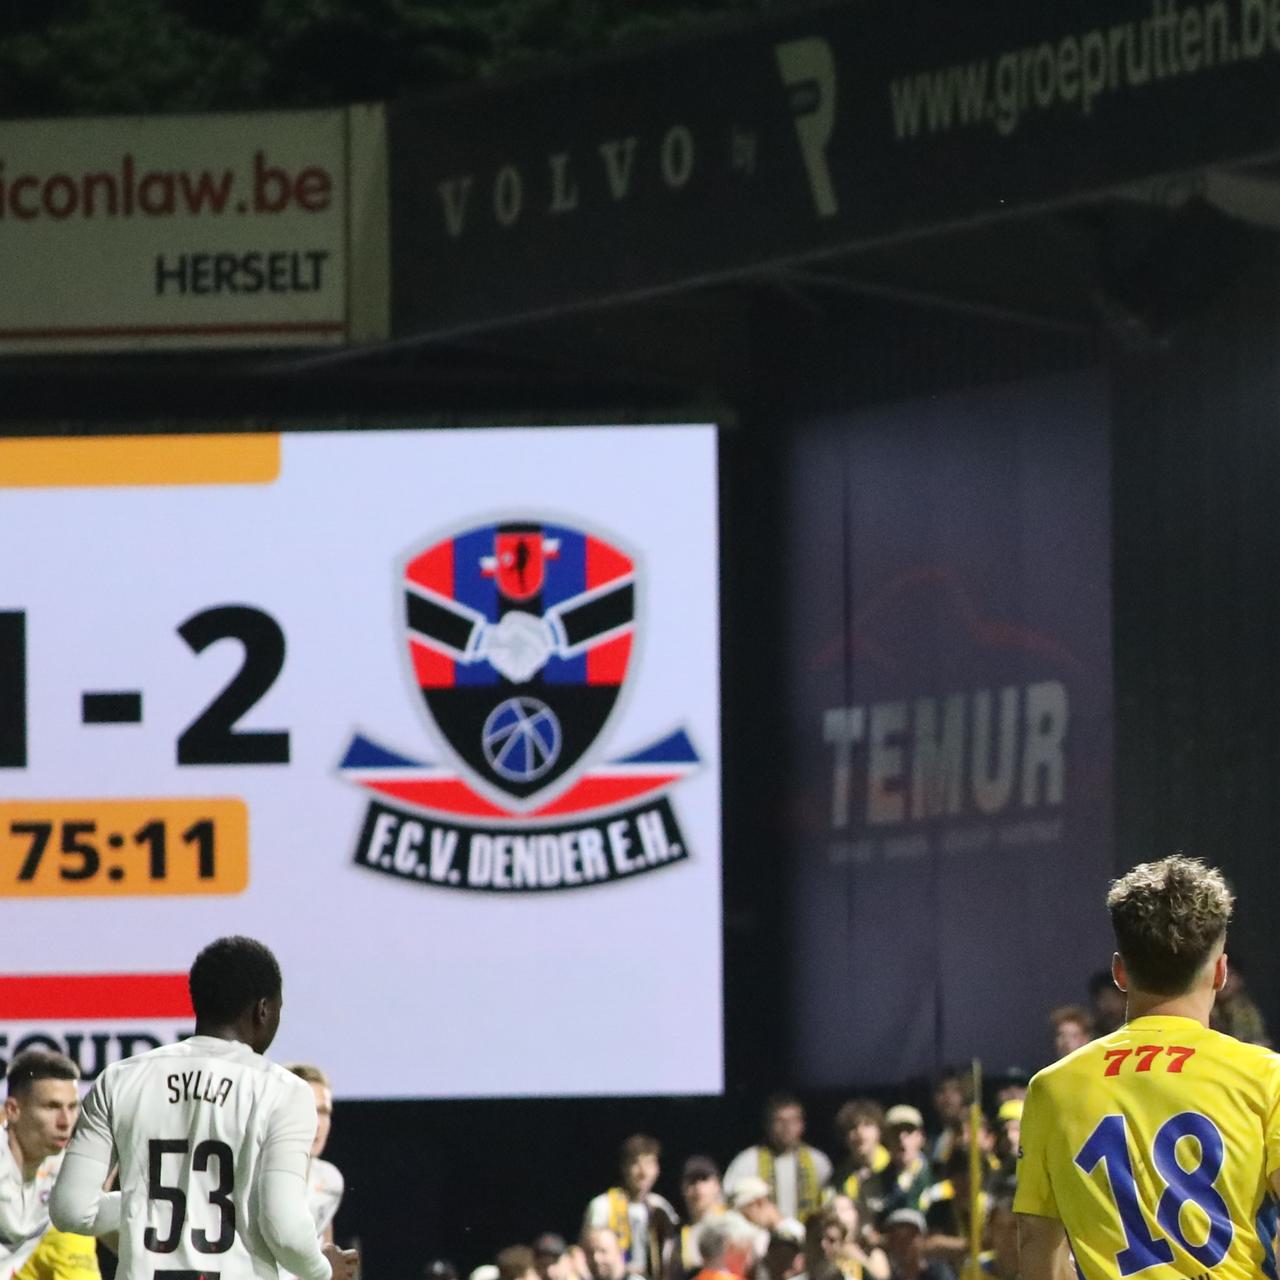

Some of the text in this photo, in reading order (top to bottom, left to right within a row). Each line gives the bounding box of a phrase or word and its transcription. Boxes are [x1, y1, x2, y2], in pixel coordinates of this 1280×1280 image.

[437, 126, 696, 239] VOLVO
[155, 251, 329, 295] HERSELT
[9, 817, 217, 884] 75:11
[467, 827, 609, 889] DENDER
[608, 808, 682, 874] E.H.
[167, 1070, 233, 1107] SYLLA
[1104, 1045, 1196, 1077] 777
[143, 1138, 236, 1254] 53
[1073, 1111, 1233, 1278] 18
